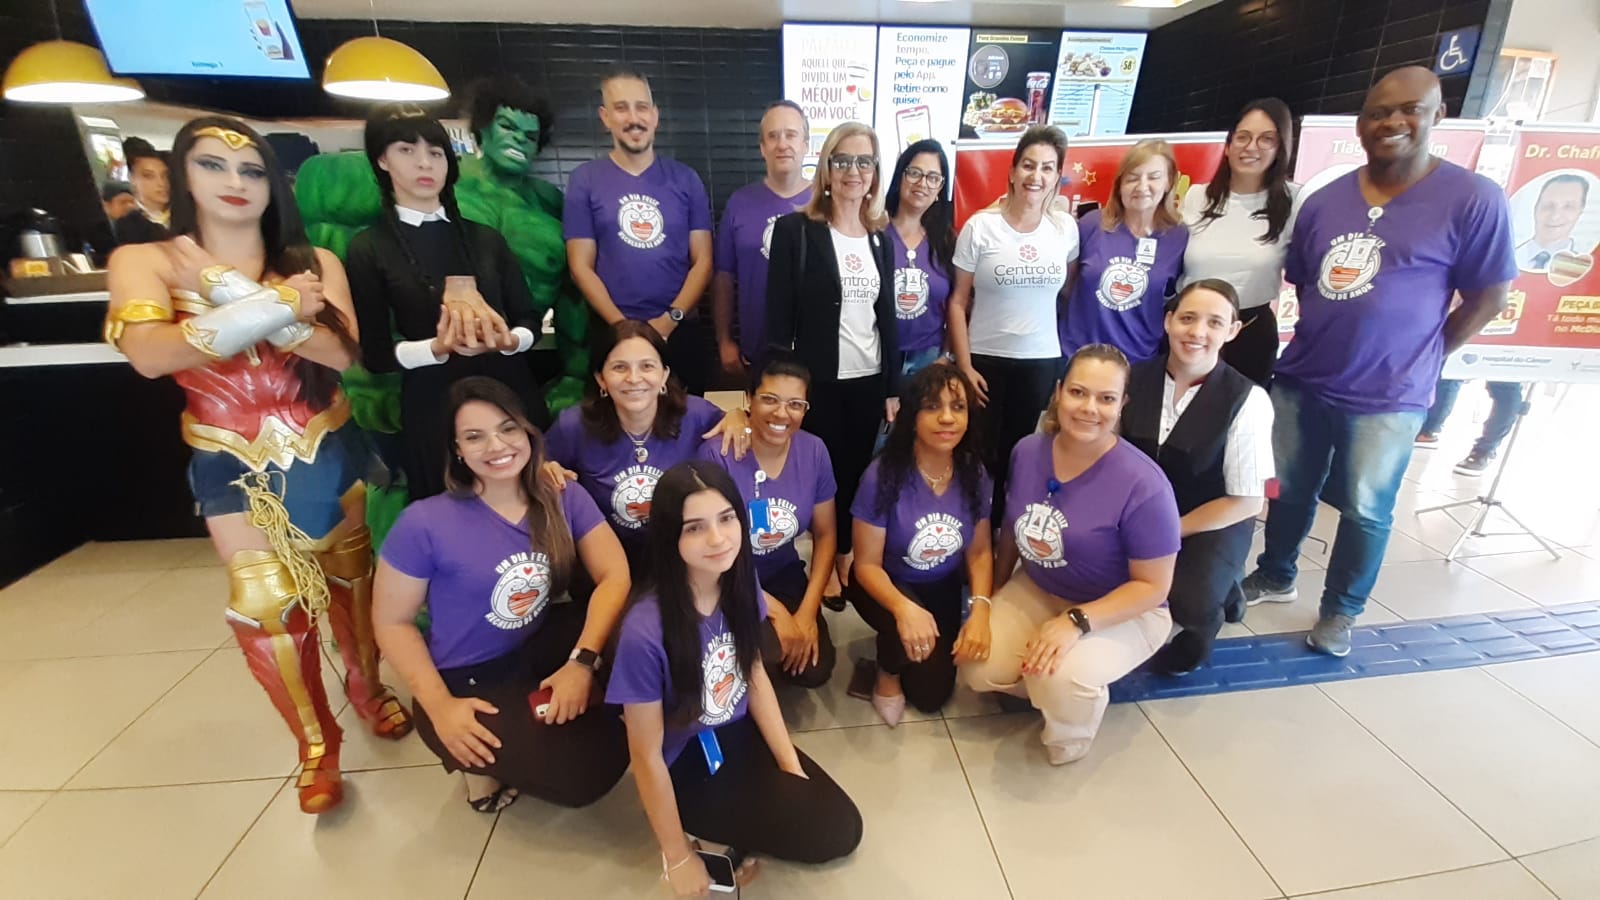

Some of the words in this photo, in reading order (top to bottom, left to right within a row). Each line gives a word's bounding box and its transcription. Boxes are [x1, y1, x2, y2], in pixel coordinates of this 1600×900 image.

[897, 32, 948, 42] Economize
[895, 56, 918, 69] Peça
[927, 58, 956, 68] pague
[802, 72, 830, 83] DIVIDE
[832, 72, 847, 83] UM
[894, 70, 914, 81] pelo
[802, 84, 842, 105] MÉQUI
[893, 83, 921, 93] Retire
[1525, 144, 1551, 158] Dr.
[994, 264, 1046, 277] Centro
[1047, 261, 1062, 275] de
[994, 275, 1062, 286] Voluntários
[1349, 283, 1375, 299] AMOR
[1562, 300, 1590, 311] PEÇA
[614, 470, 628, 483] UM
[627, 464, 641, 475] DIA
[777, 498, 797, 512] FELIZ
[915, 516, 928, 529] UM
[926, 512, 941, 522] DIA
[942, 513, 963, 529] FELIZ
[495, 559, 511, 573] UM
[510, 552, 528, 563] DIA
[732, 681, 748, 705] AMOR
